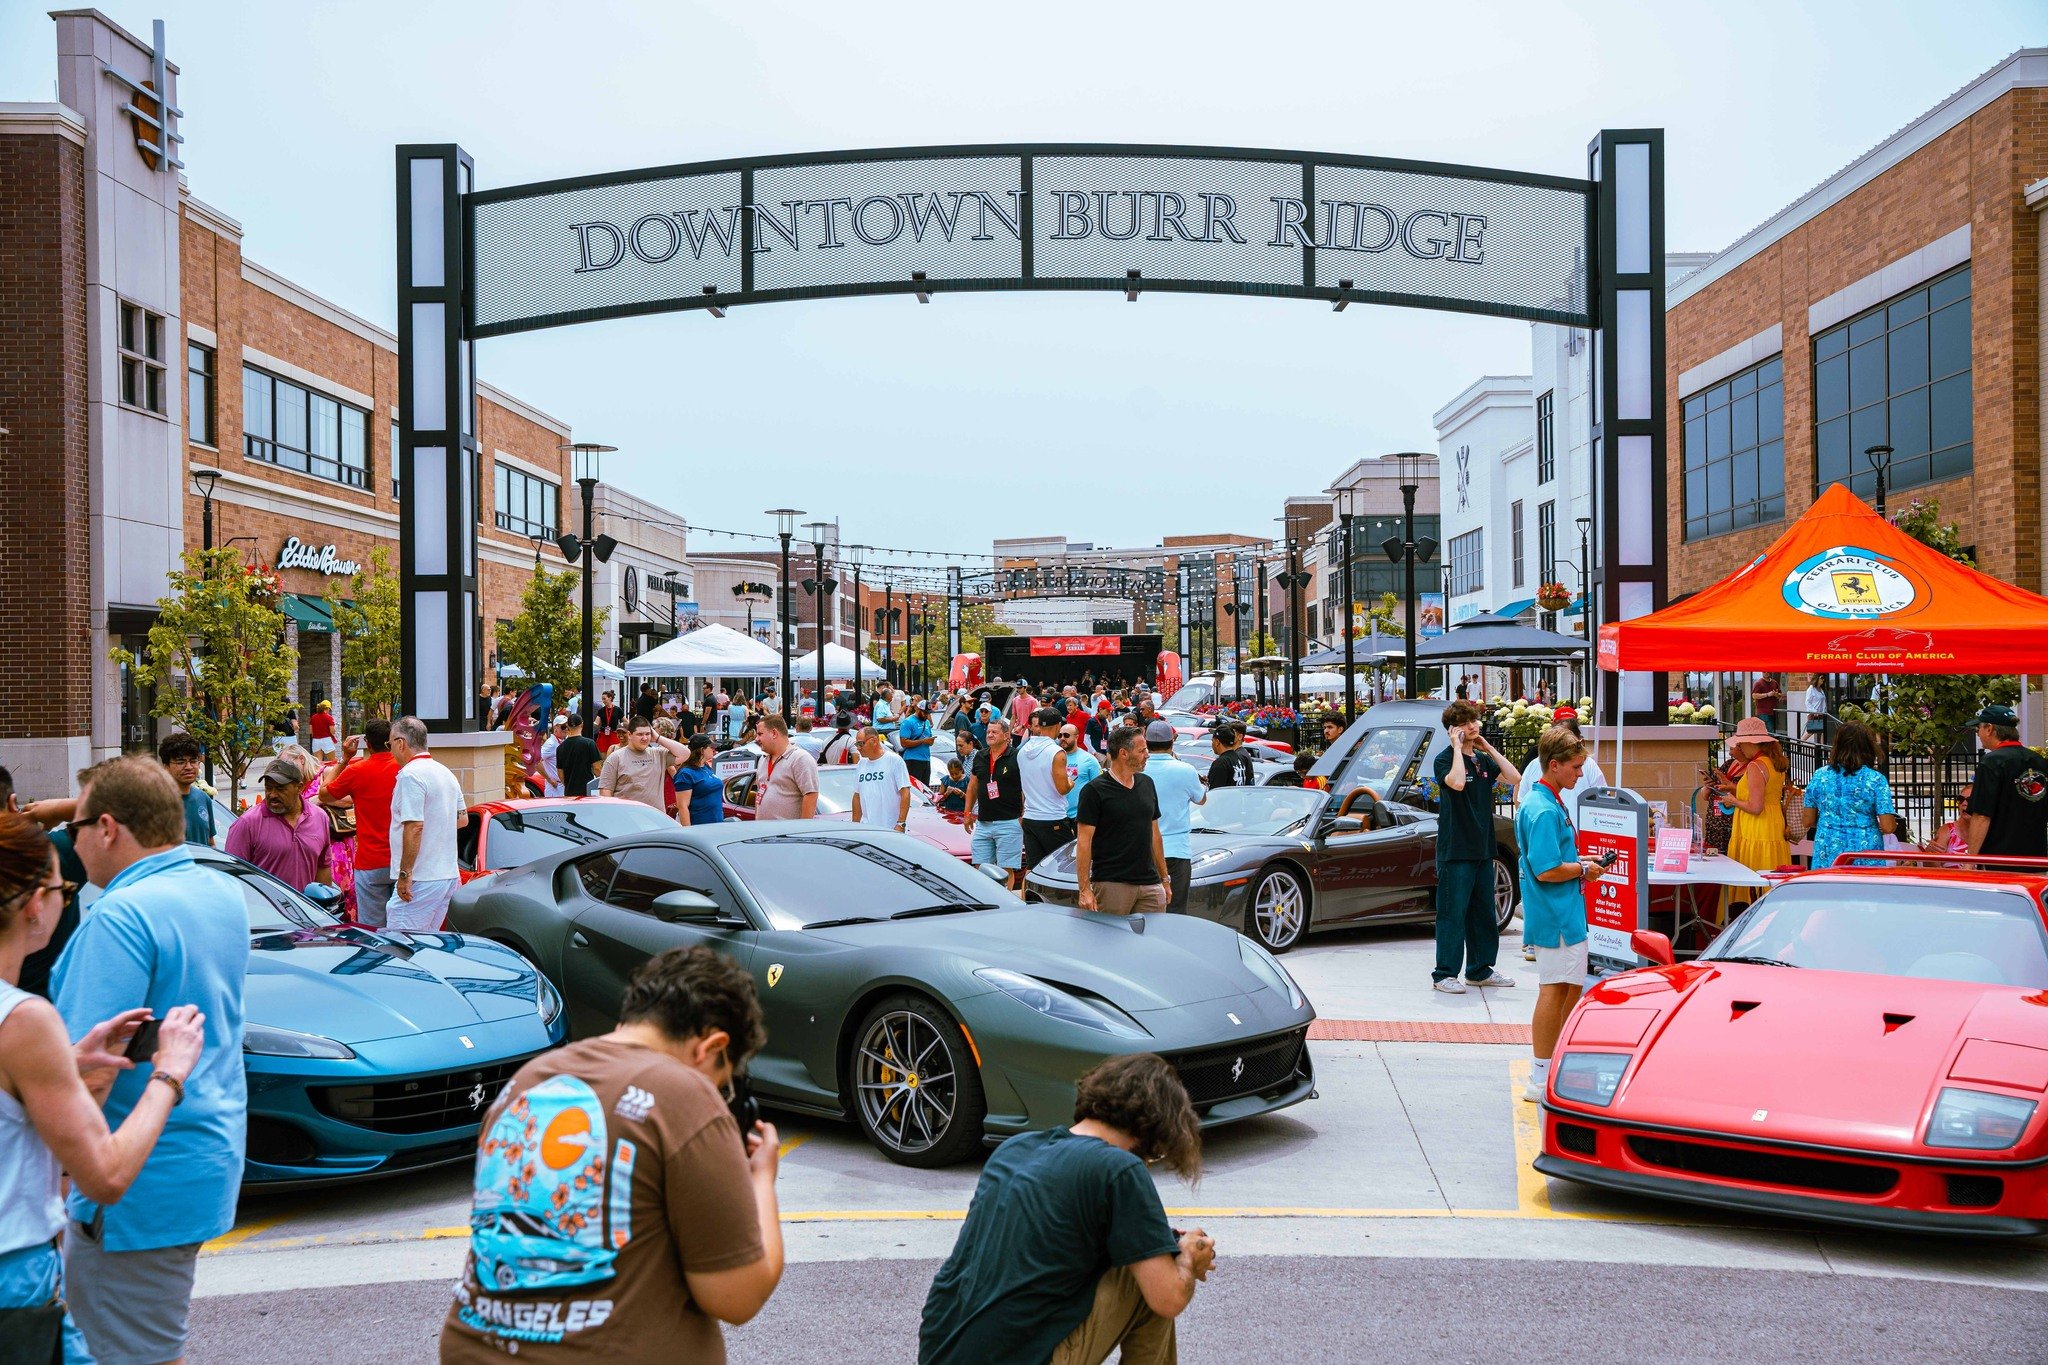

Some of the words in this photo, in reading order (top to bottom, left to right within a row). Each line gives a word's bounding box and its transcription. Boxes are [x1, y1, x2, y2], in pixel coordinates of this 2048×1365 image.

[569, 188, 1028, 273] DOWNTOWN
[1050, 190, 1247, 245] BURR
[1267, 196, 1488, 265] RIDGE
[278, 536, 320, 570] Eddie
[319, 544, 361, 576] Bauer
[1806, 556, 1861, 582] FERRARI
[1865, 561, 1899, 580] CLUB
[1817, 601, 1838, 610] OF
[1840, 600, 1906, 614] AMERICA
[1806, 652, 1853, 660] FERRARI
[1855, 652, 1885, 660] CLUB
[1905, 652, 1955, 660] AMERICA
[859, 771, 884, 783] BOSS
[475, 1297, 614, 1332] ANGELES
